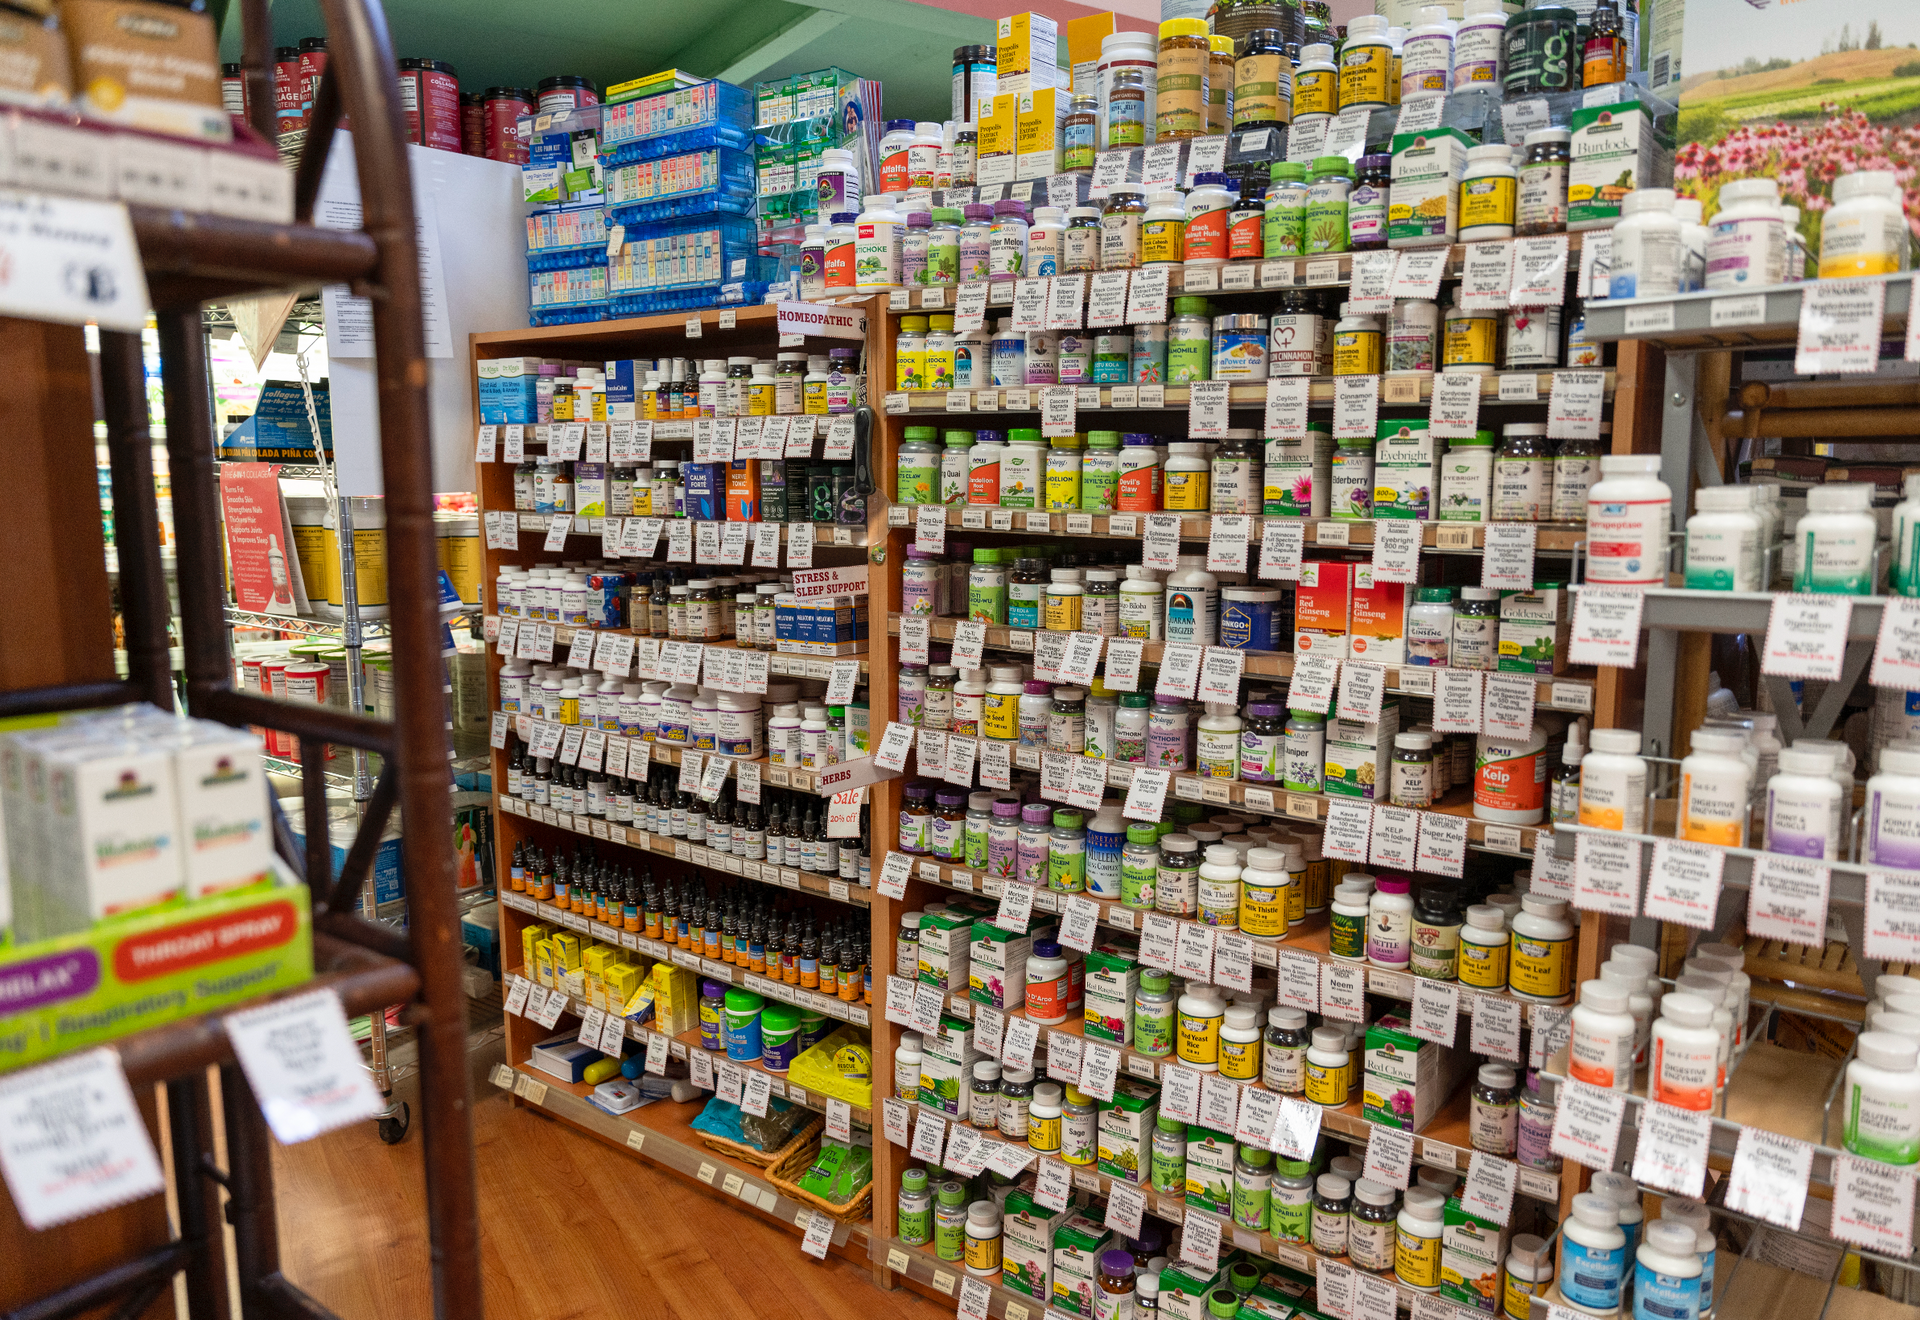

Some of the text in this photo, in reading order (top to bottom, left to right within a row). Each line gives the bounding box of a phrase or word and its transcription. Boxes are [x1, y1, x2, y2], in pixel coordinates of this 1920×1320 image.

[998, 42, 1019, 54] Propolis
[980, 123, 1002, 134] Propolis
[1019, 118, 1042, 129] Propolis
[1578, 138, 1630, 154] Burdock
[882, 164, 907, 175] Alfalfa
[780, 311, 852, 327] HOMEOPATHIC
[265, 391, 300, 400] collagen
[1340, 392, 1372, 400] Cinnamon
[282, 448, 300, 457] PIÑA
[1268, 452, 1310, 462] Echinacea
[1380, 450, 1428, 462] Eyebright
[1381, 537, 1414, 545] Eyebright
[795, 573, 830, 584] STRESS
[796, 581, 866, 597] SLEEP SUPPORT
[1354, 602, 1369, 610] Red
[1299, 607, 1330, 618] Ginseng
[1354, 610, 1386, 620] Ginseng
[1504, 608, 1554, 619] Goldenseal
[822, 770, 851, 785] HERBS
[1483, 768, 1510, 783] Kelp
[1245, 904, 1256, 912] Milk
[1516, 960, 1550, 973] Olive Leaf
[1330, 980, 1354, 989] Neem
[1186, 1040, 1199, 1048] Rice
[1190, 1034, 1208, 1045] Yeast
[1069, 1128, 1086, 1138] Sage
